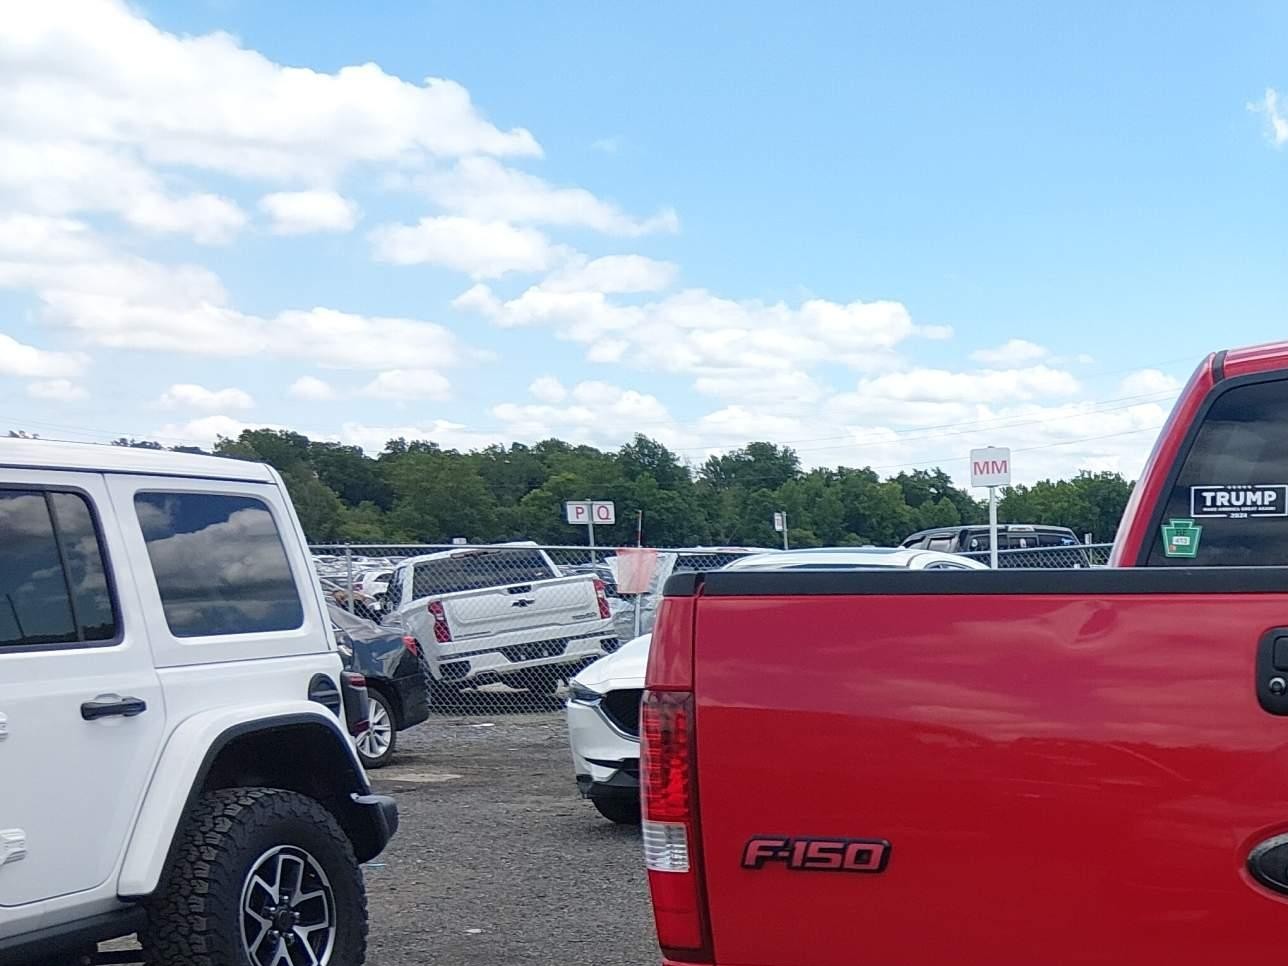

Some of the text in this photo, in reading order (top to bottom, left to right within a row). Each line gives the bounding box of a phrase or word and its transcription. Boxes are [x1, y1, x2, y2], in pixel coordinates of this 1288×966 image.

[973, 460, 1008, 476] MM
[1201, 490, 1277, 506] TRUMP
[575, 506, 585, 520] P
[596, 505, 611, 520] Q
[742, 837, 889, 872] F-150
